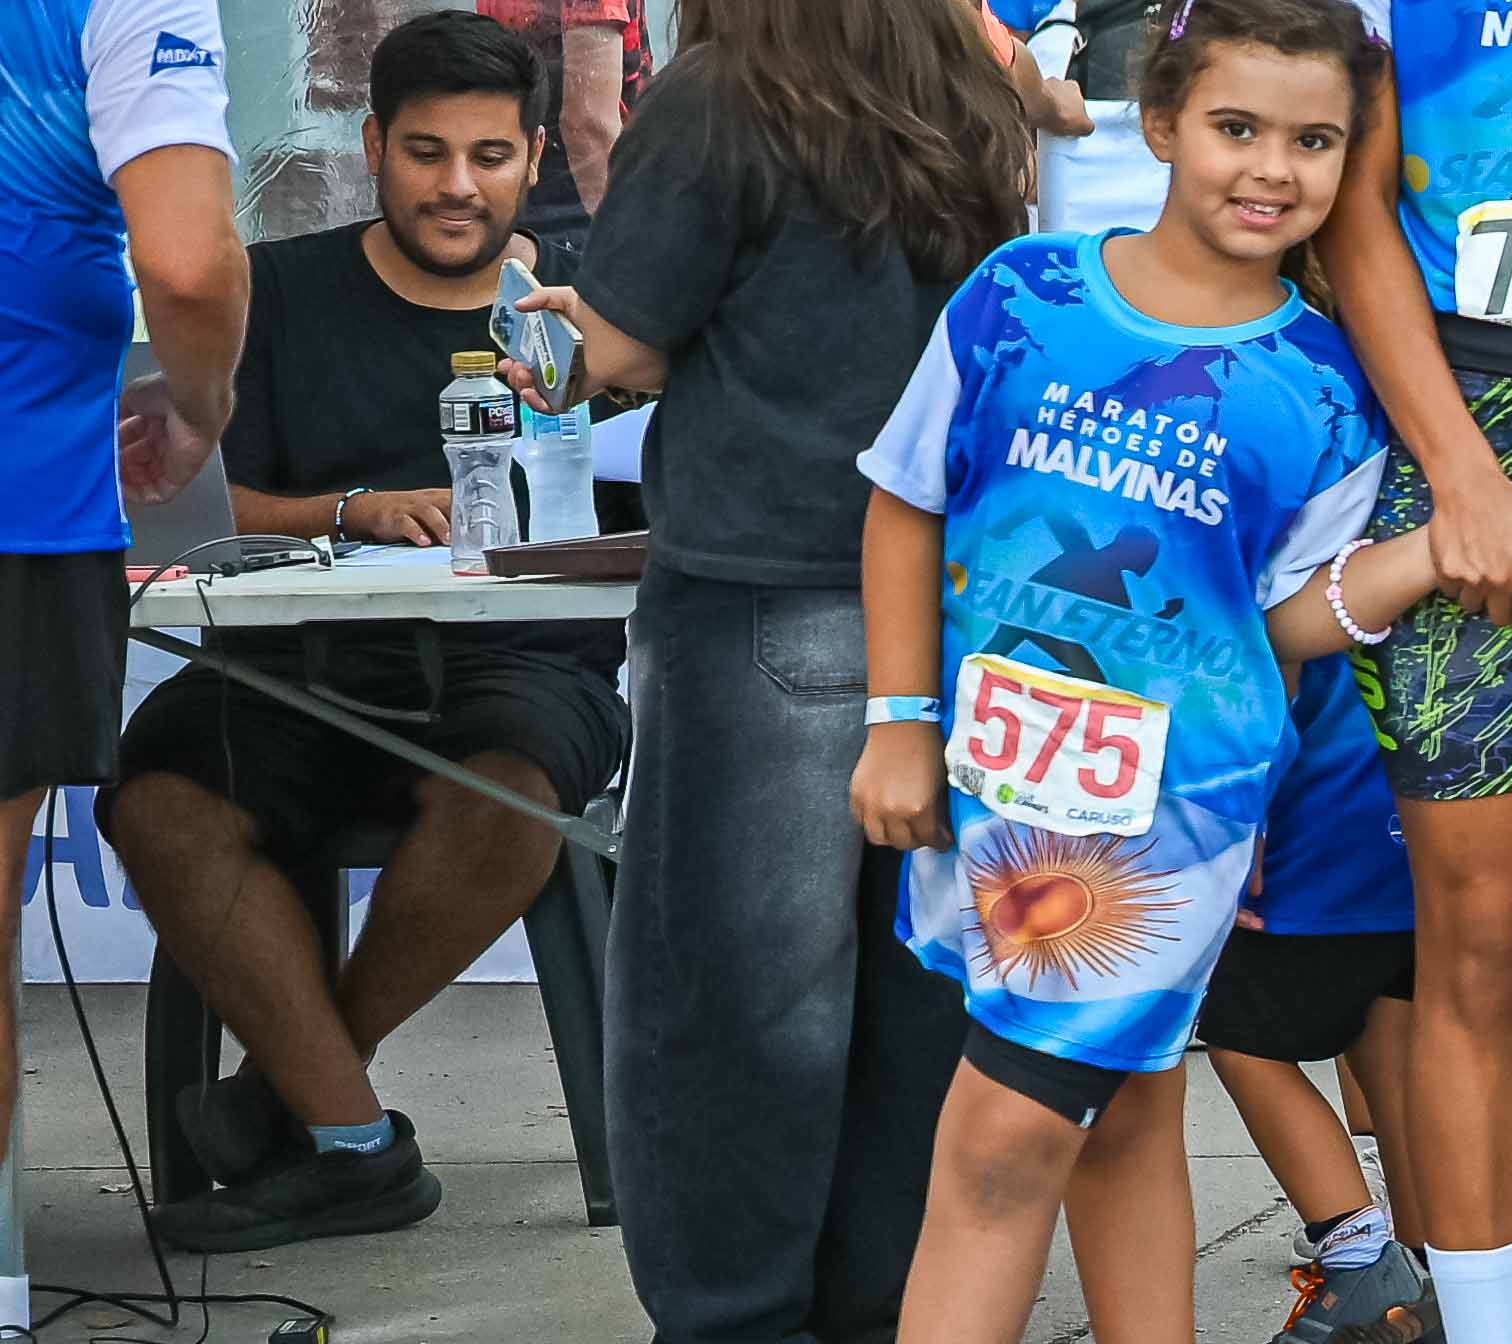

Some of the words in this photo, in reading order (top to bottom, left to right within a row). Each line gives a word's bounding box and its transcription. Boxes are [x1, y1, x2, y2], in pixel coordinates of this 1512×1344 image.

[1038, 405, 1162, 458] HÉROES
[1176, 452, 1217, 478] DE
[1042, 381, 1228, 456] MARATÓN
[1007, 428, 1230, 527] MALVINAS
[968, 574, 1060, 626] EAN
[1065, 598, 1240, 678] ETERNO
[967, 668, 1144, 800] 575
[1065, 808, 1133, 826] CARUSO
